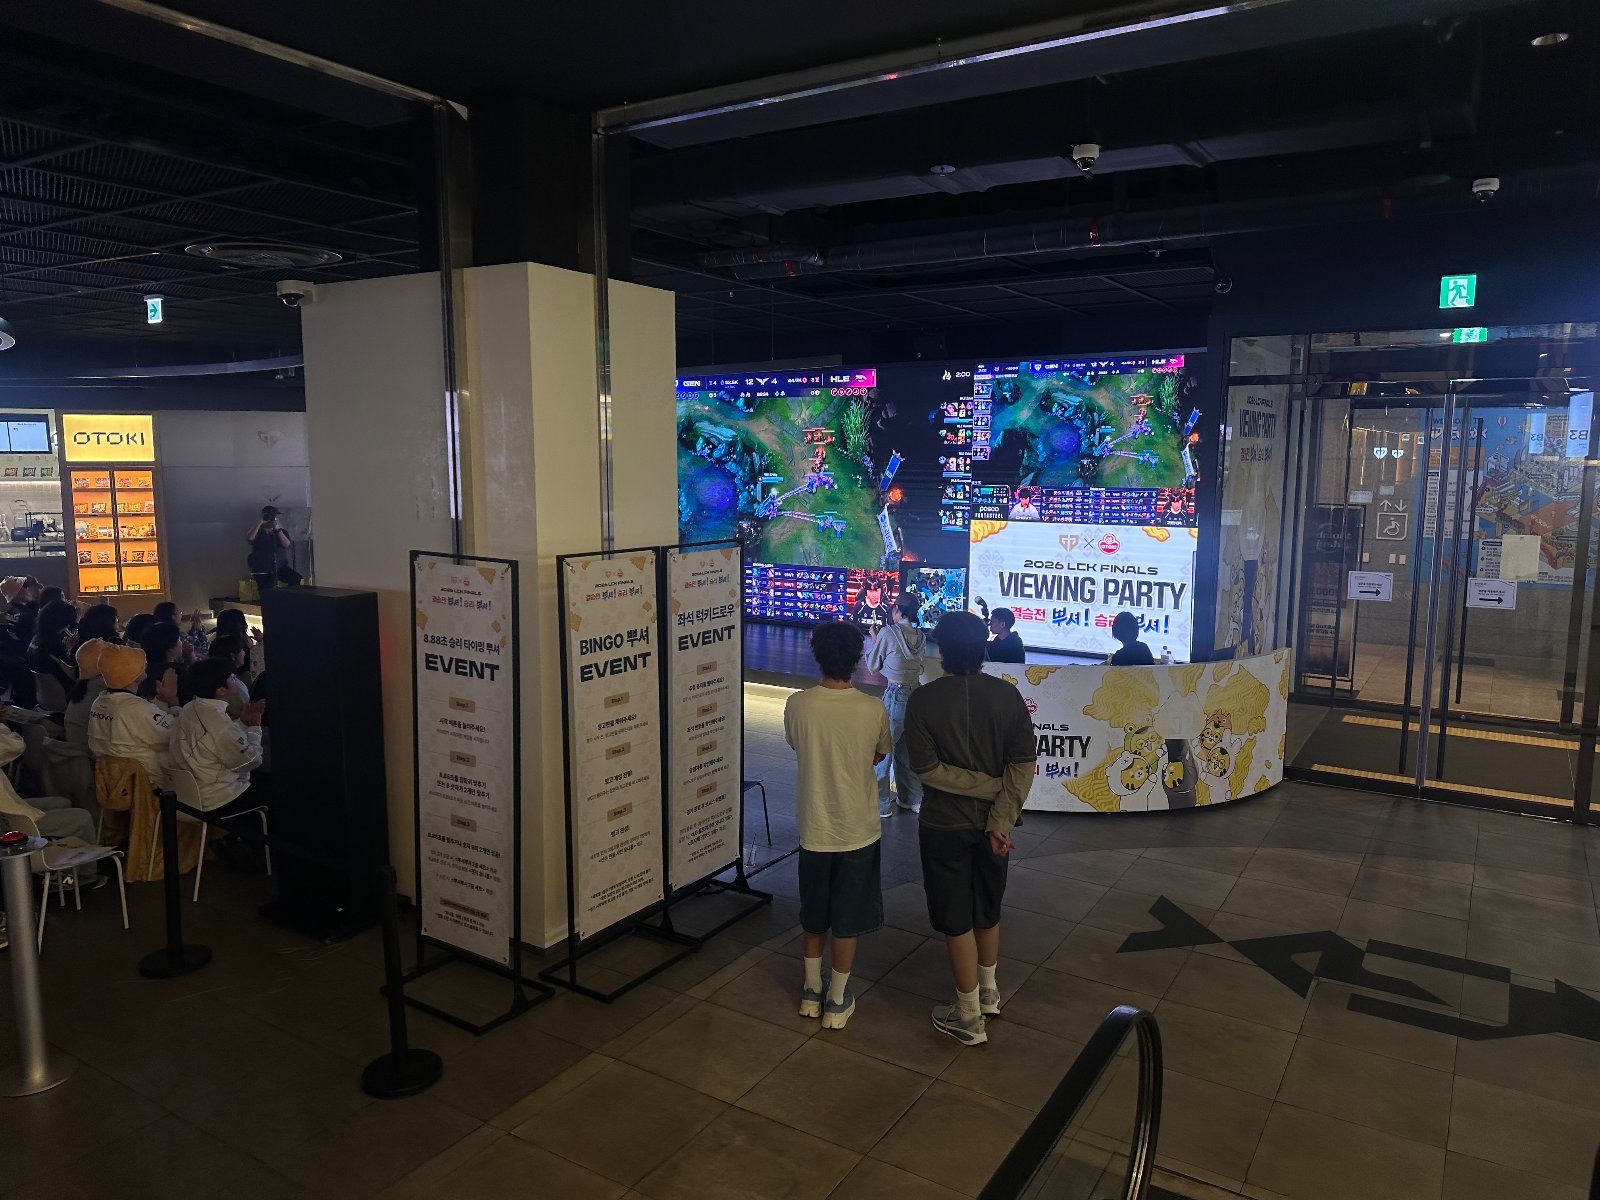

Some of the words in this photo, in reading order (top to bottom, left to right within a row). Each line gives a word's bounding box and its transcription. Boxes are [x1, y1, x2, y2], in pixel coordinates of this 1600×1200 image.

[74, 432, 145, 445] OTOKI
[1024, 560, 1064, 569] 2026
[1067, 563, 1096, 572] LCK
[1100, 564, 1158, 575] FINALS
[999, 571, 1096, 604] VIEWING
[1103, 578, 1187, 610] PARTY
[678, 611, 694, 626] 좌석
[696, 604, 735, 623] 럭키드로우
[1052, 607, 1089, 627] 뿌셔!
[423, 634, 448, 646] 8.88초
[449, 637, 462, 649] 승리
[464, 639, 484, 652] 타이밍
[486, 642, 500, 655] 뿌셔
[580, 633, 624, 655] BINGO
[627, 626, 649, 647] 뿌셔
[678, 625, 735, 651] EVENT
[425, 653, 500, 681] EVENT
[580, 651, 651, 682] EVENT
[1032, 723, 1069, 731] NALS
[1034, 734, 1091, 758] ARTY
[1046, 762, 1079, 779] 뿌셔!
